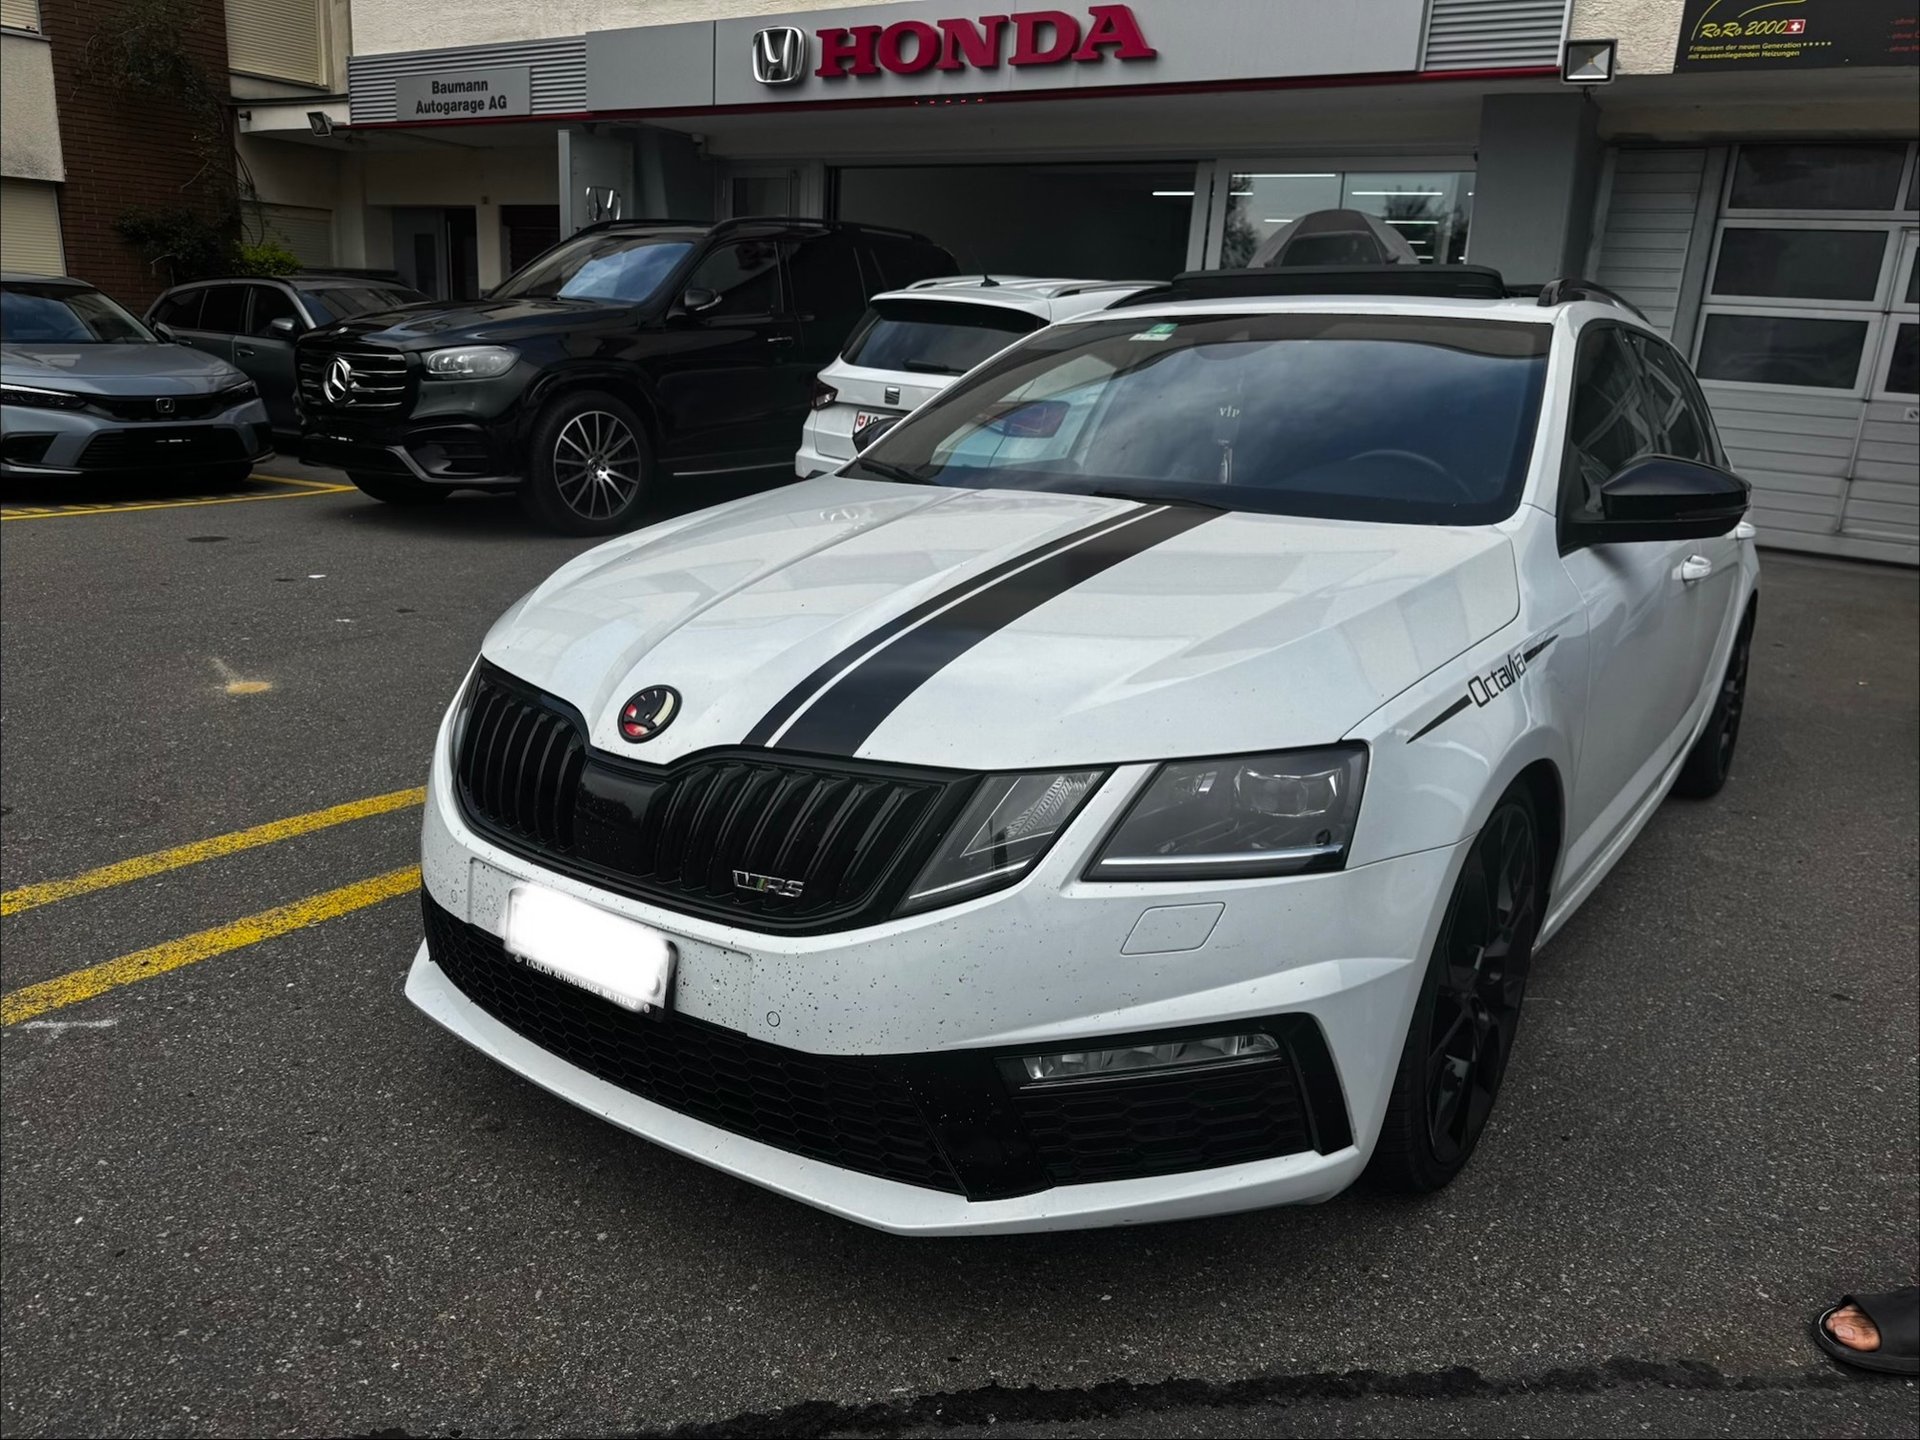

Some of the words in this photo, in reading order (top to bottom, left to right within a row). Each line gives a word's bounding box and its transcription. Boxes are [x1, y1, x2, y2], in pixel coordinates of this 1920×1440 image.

[1700, 22, 1742, 38] RoRo
[1745, 20, 1789, 35] 2000
[815, 4, 1157, 77] HONDA
[1725, 42, 1738, 51] der
[1738, 43, 1761, 51] neuen
[1687, 52, 1700, 60] mit
[1761, 49, 1800, 59] Heizungen
[431, 80, 489, 95] Baumann
[416, 99, 485, 115] Autogarage
[488, 95, 507, 110] AG
